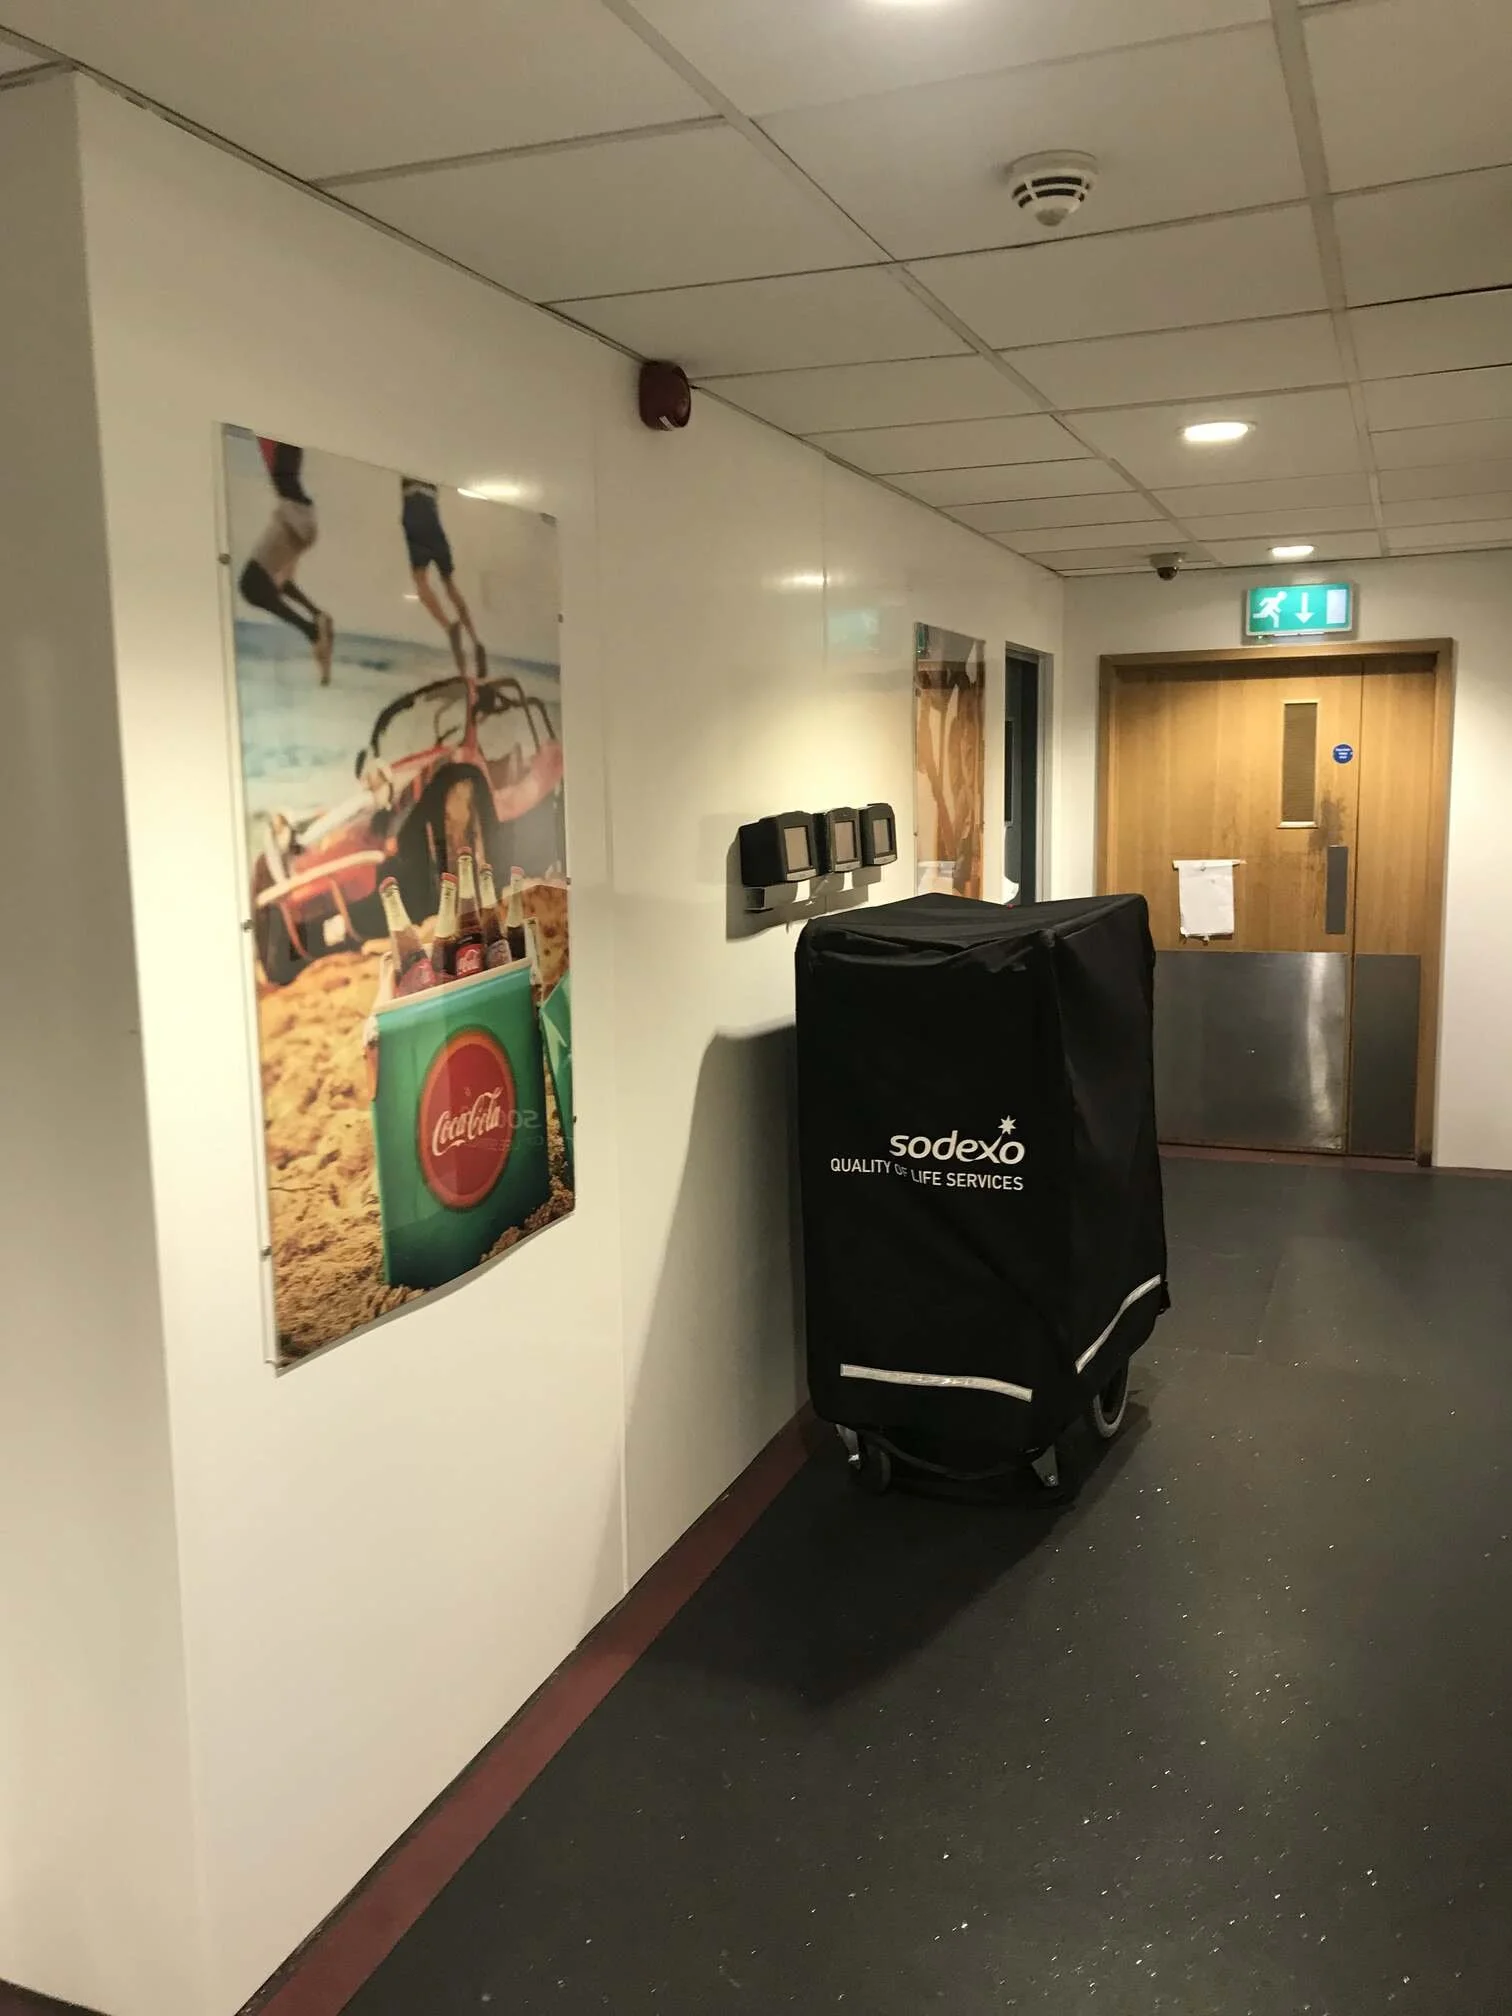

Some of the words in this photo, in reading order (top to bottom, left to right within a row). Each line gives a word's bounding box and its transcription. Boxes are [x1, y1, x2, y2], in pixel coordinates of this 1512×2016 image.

[889, 1129, 1025, 1164] sodexo
[830, 1158, 890, 1173] QUALITY
[911, 1169, 943, 1186] LIFE
[946, 1173, 1024, 1191] SERVICES
